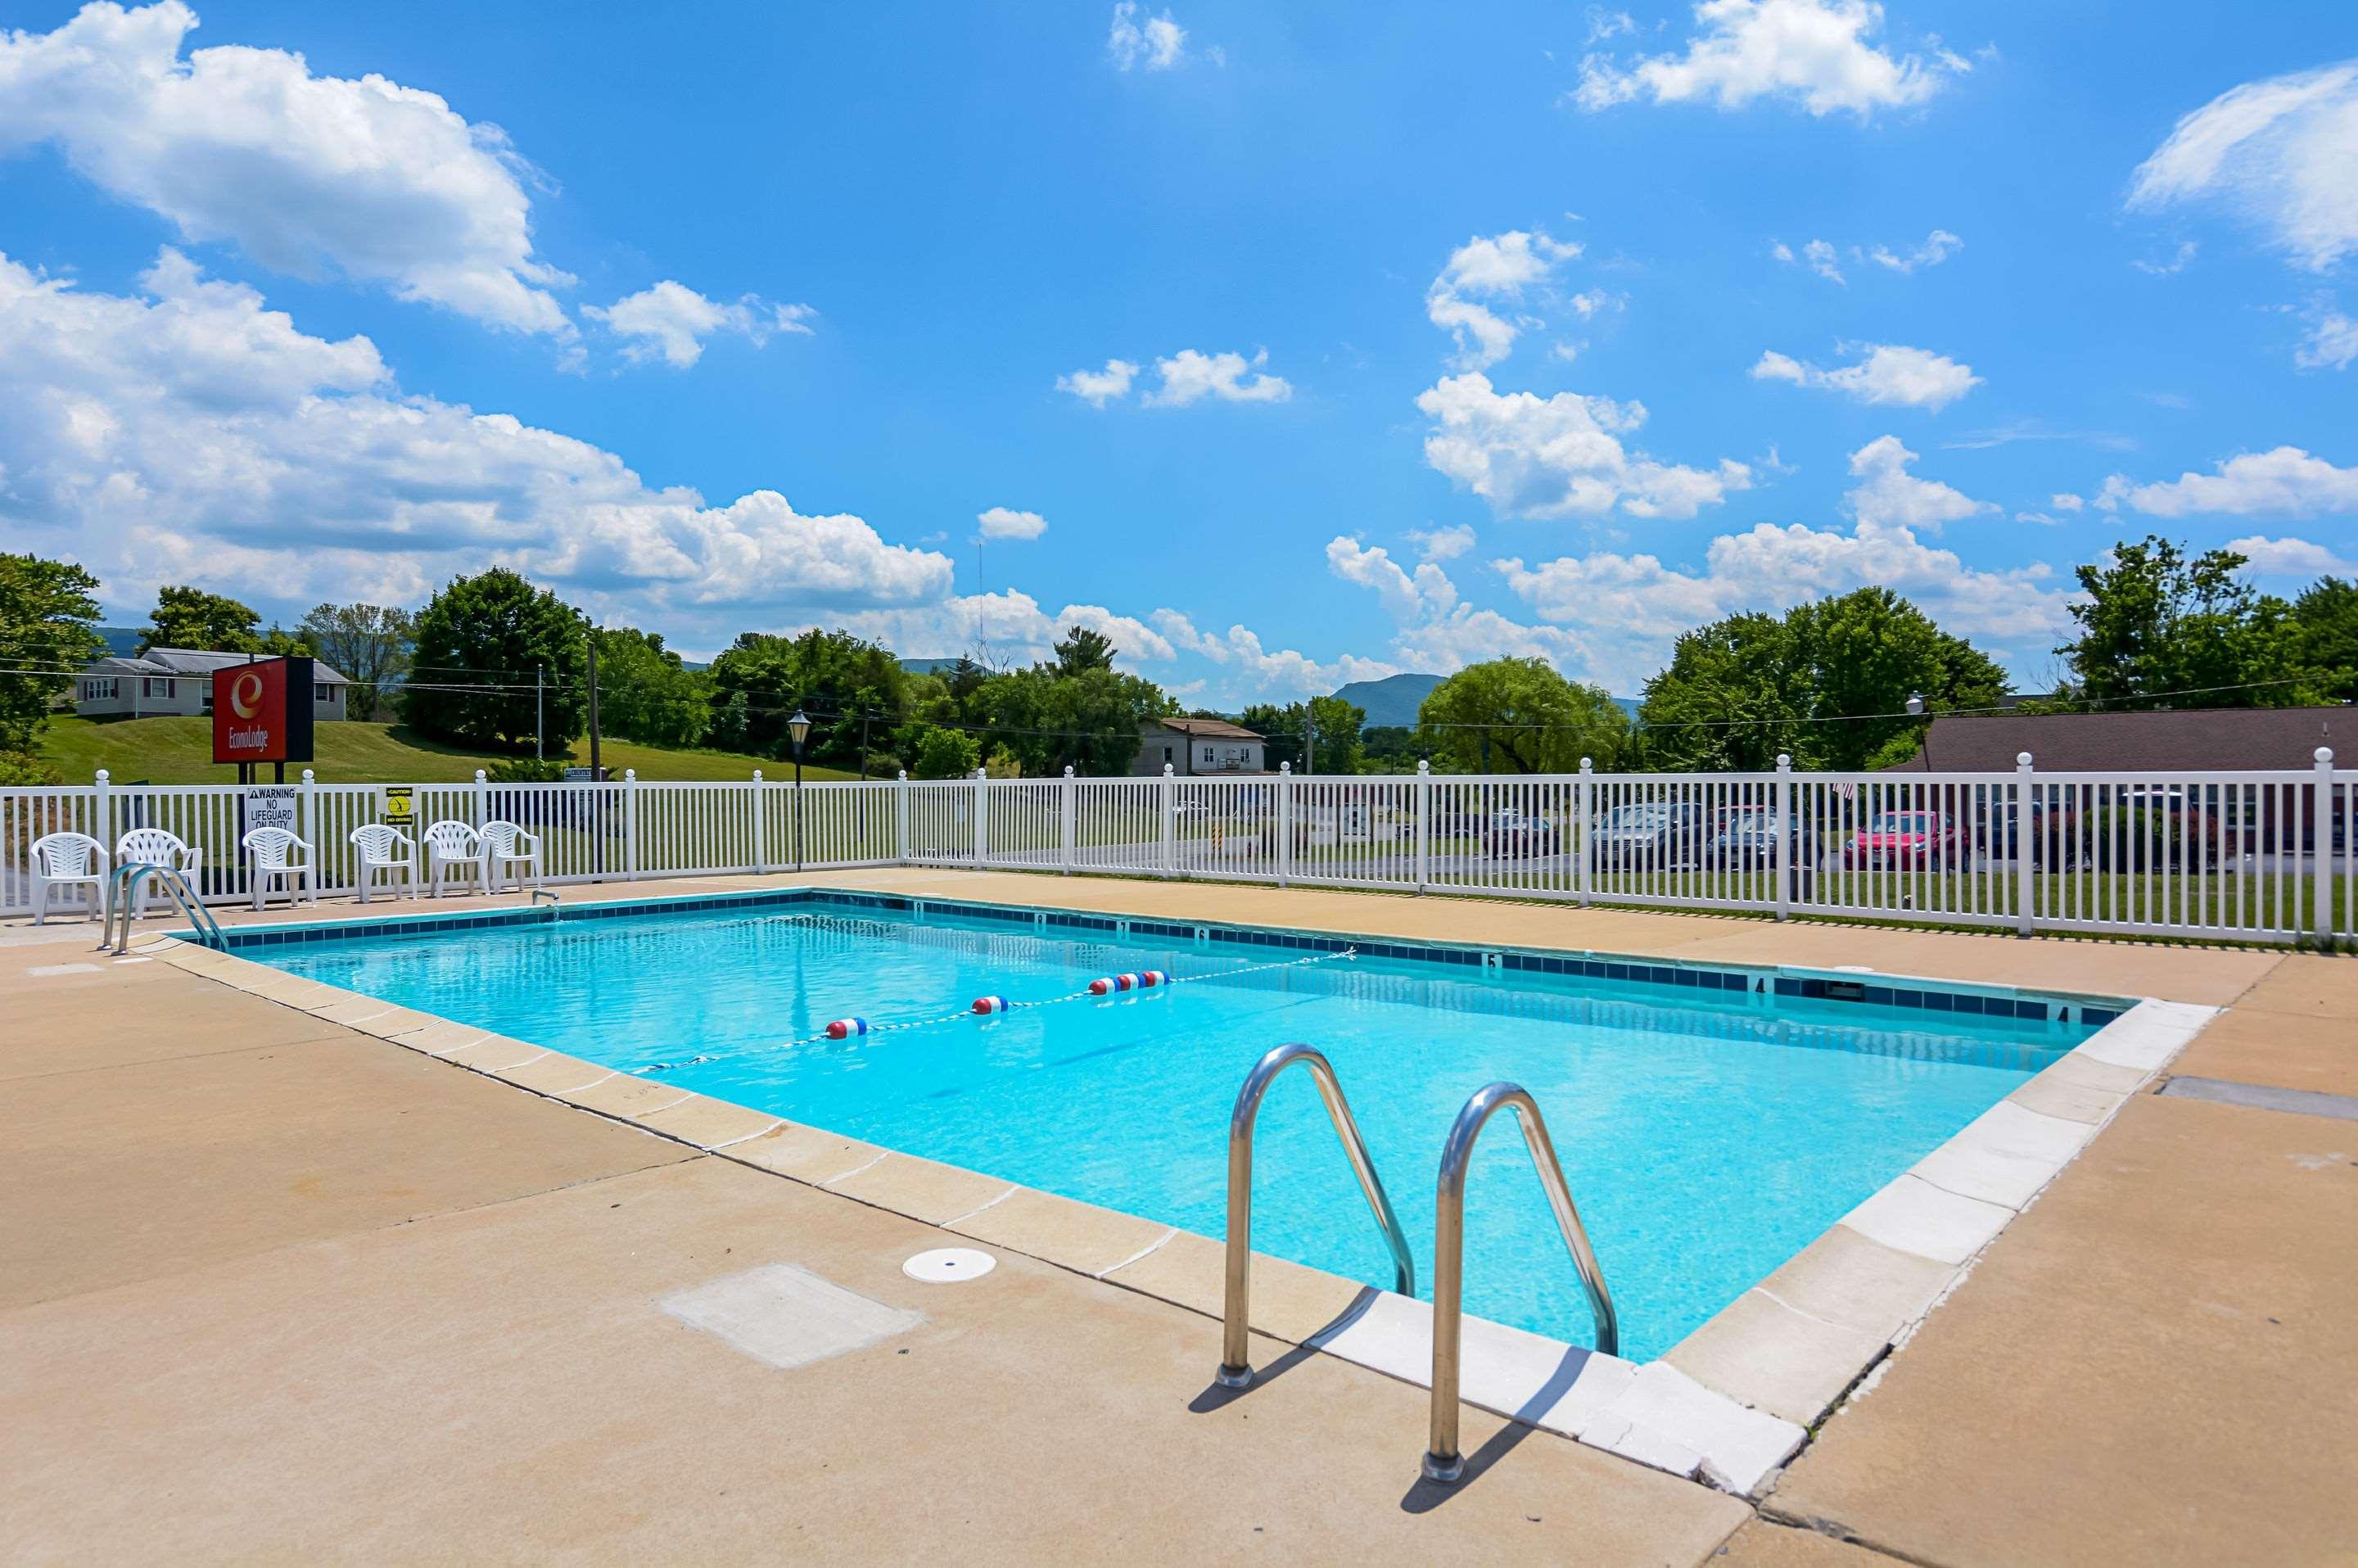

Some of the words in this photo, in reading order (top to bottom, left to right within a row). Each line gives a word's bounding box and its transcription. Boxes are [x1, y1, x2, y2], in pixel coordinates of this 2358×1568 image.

[229, 725, 268, 752] EconoLodge
[259, 789, 295, 799] WARNING
[266, 799, 278, 810] NO
[251, 810, 292, 820] LIFEGUARD
[269, 820, 288, 829] DUTY
